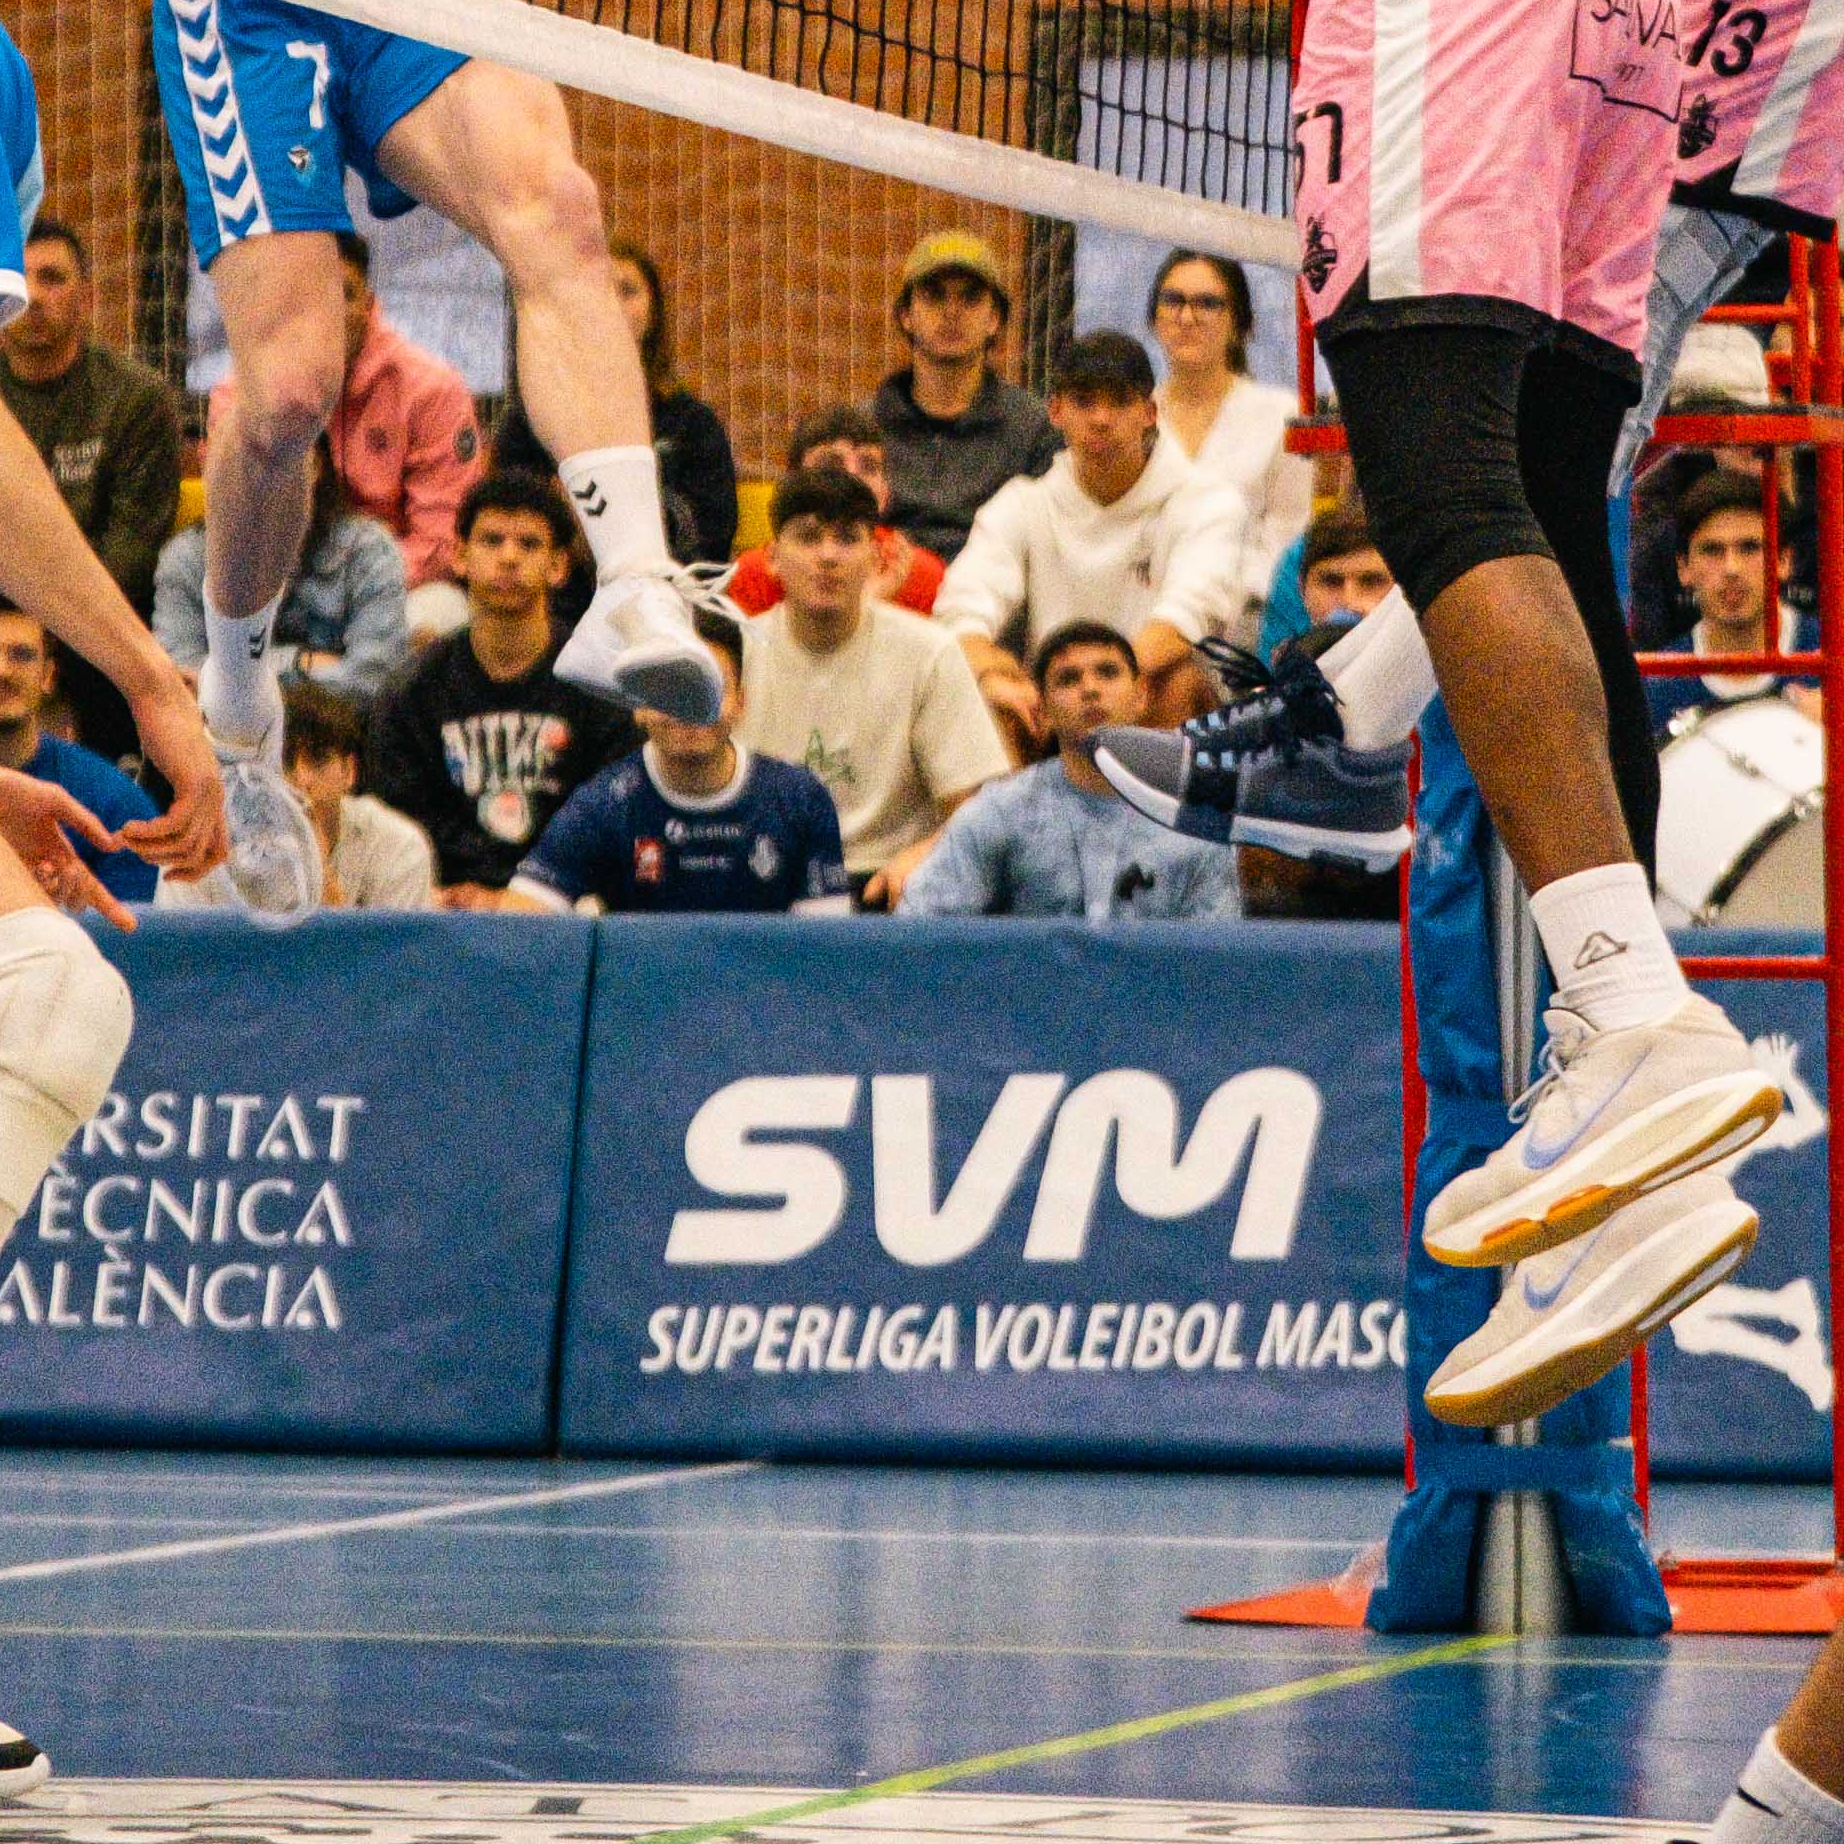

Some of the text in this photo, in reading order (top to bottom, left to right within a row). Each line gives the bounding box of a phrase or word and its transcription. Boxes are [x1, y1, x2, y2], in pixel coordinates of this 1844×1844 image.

[664, 1066, 1323, 1266] SVM
[639, 1302, 957, 1375] SUPERLIGA
[973, 1301, 1243, 1374] VOLEIBOL
